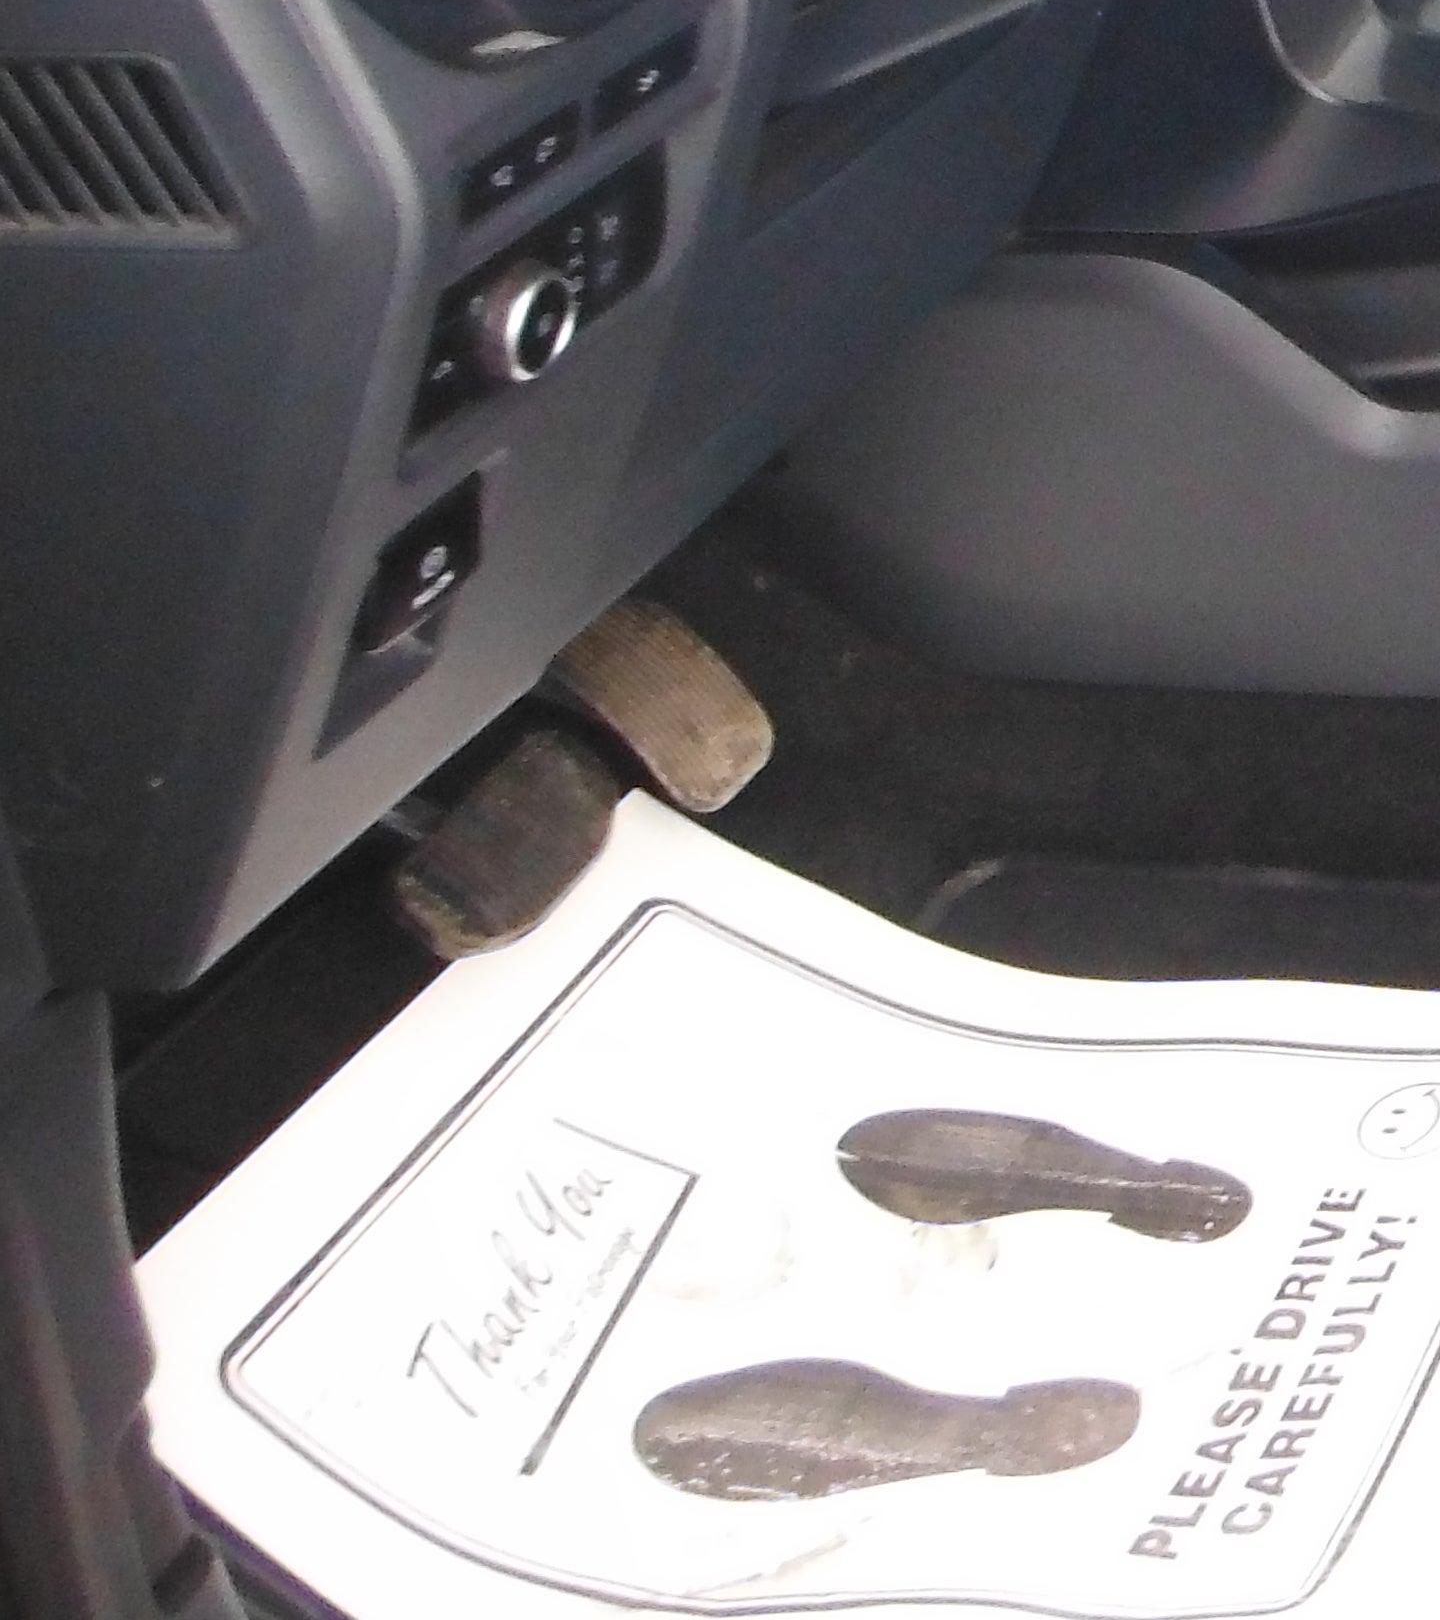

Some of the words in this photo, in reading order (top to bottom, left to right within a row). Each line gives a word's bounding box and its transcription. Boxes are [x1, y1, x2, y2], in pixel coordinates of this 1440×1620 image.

[406, 1230, 553, 1418] Thank
[516, 1169, 613, 1241] You
[1128, 1362, 1283, 1560] PLEASE
[1253, 1187, 1366, 1339] DRIVE
[1220, 1215, 1418, 1535] CAREFULLY!
